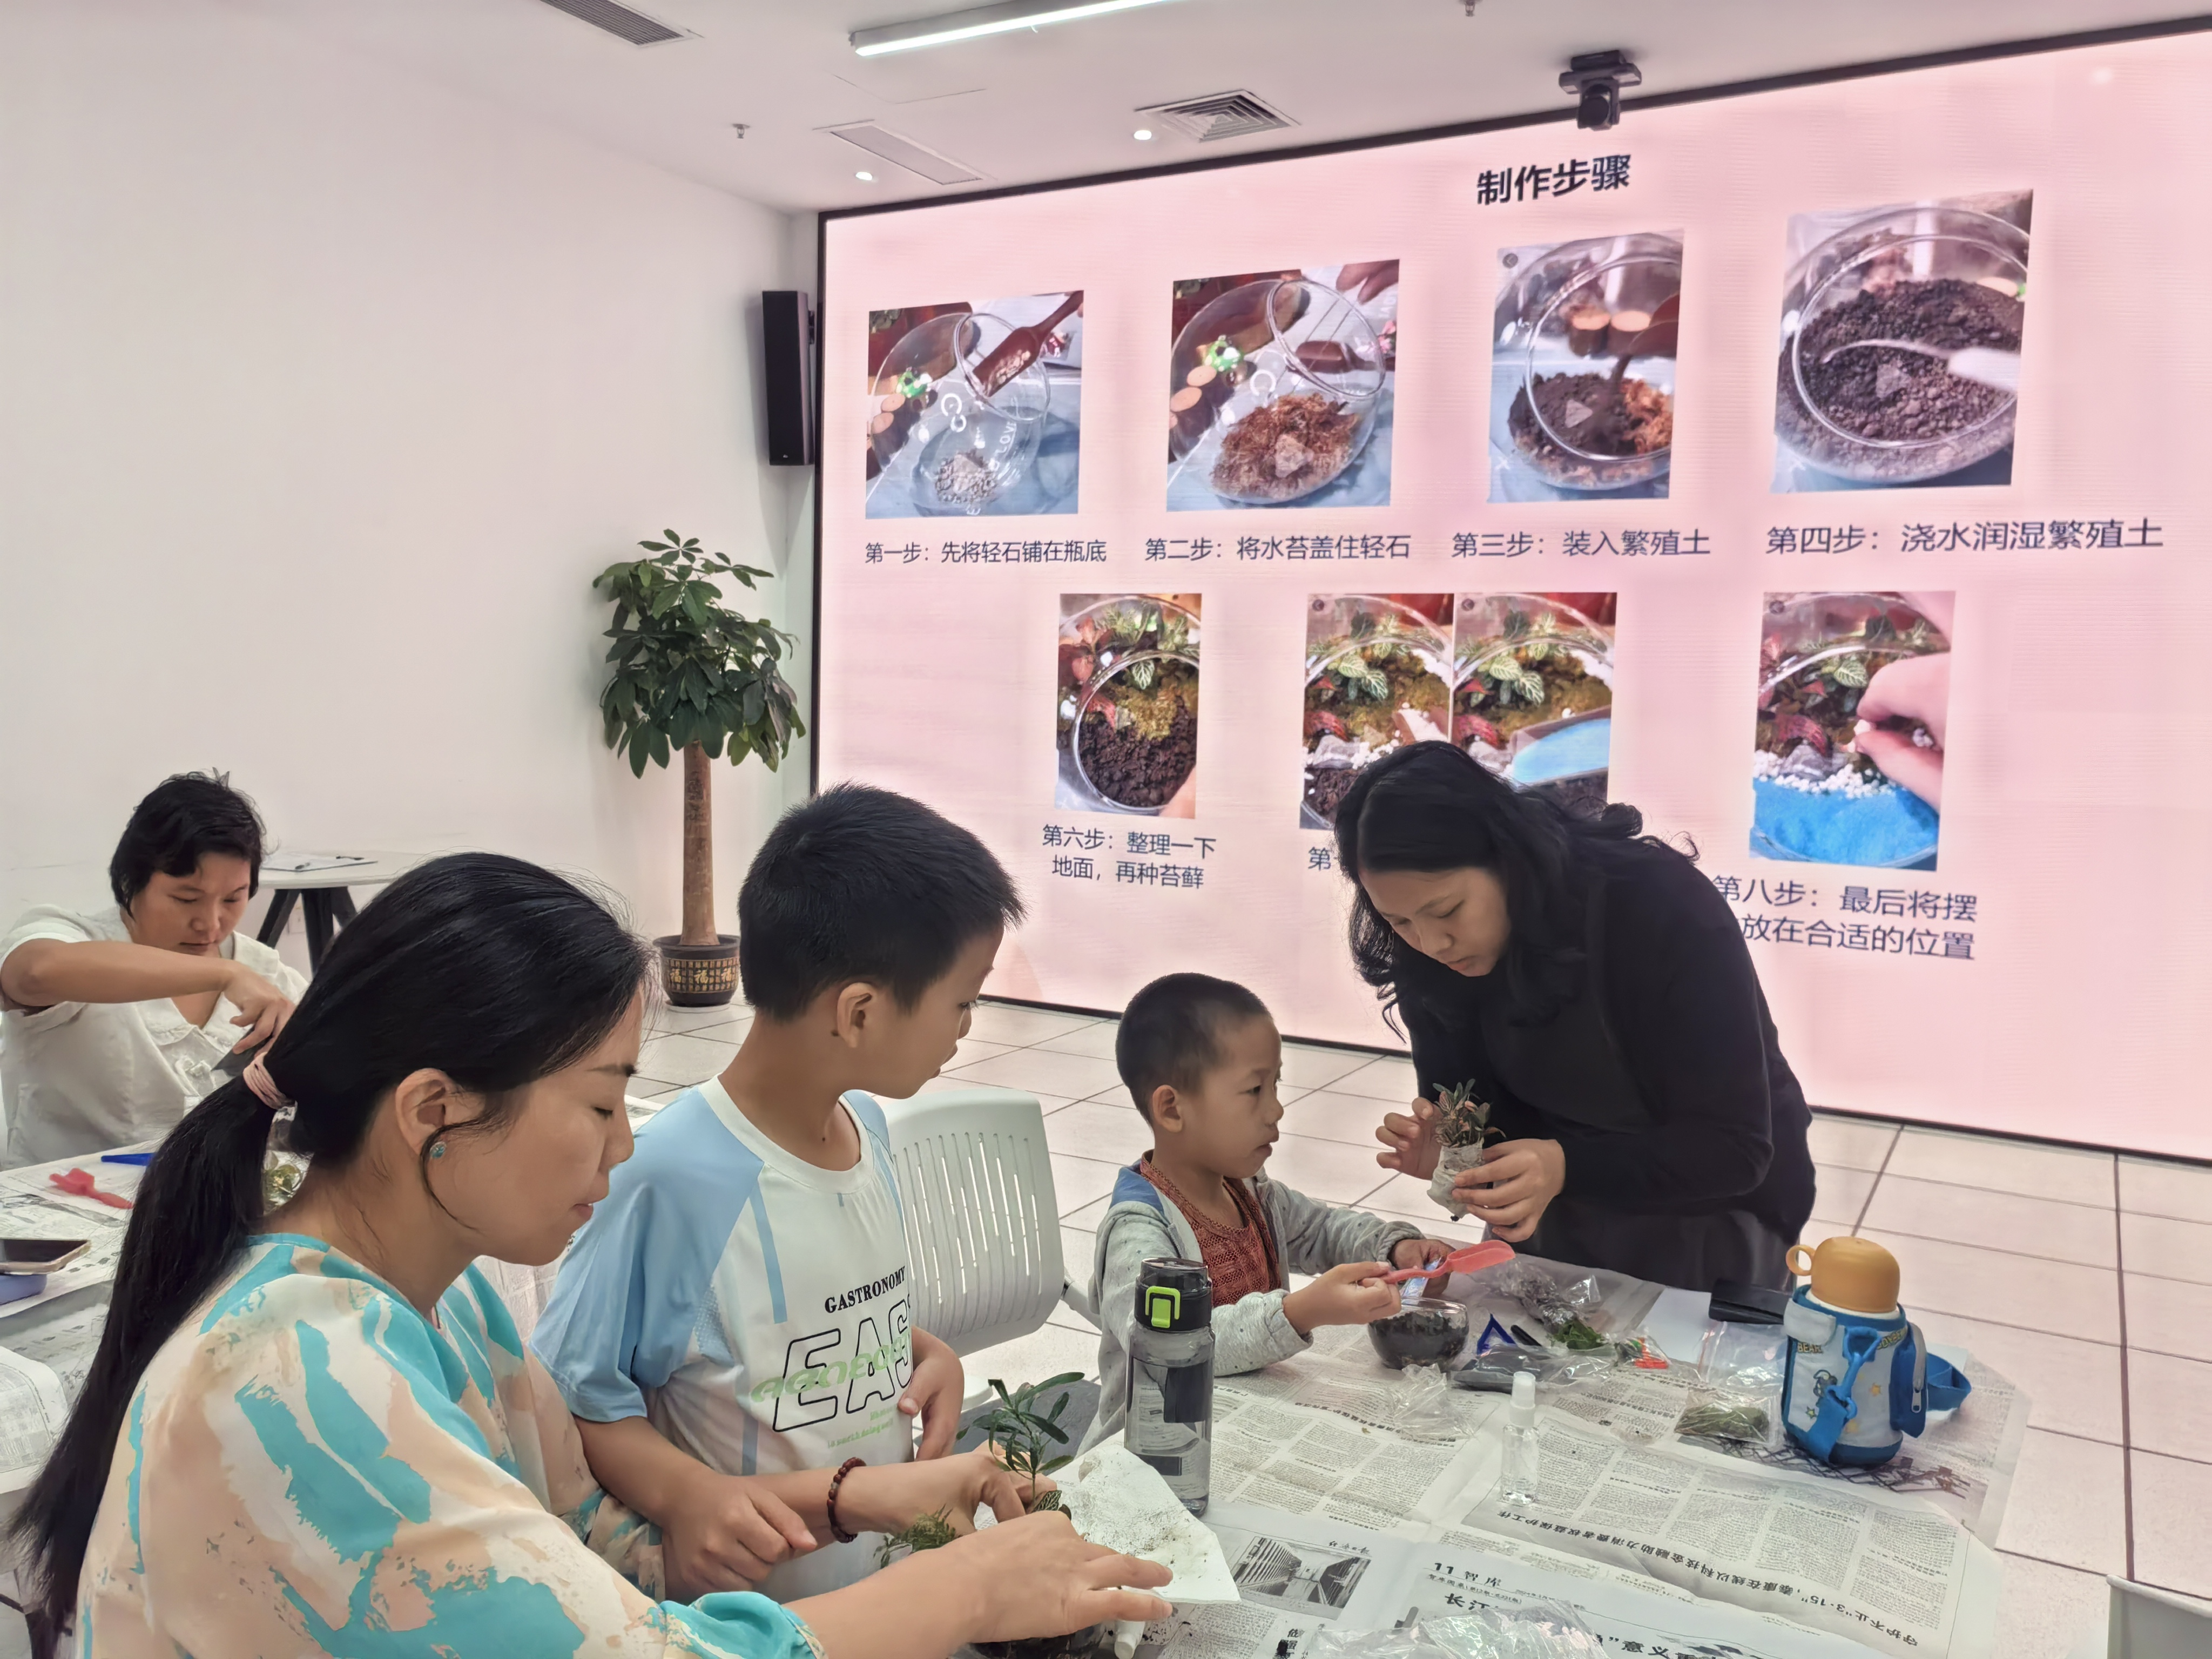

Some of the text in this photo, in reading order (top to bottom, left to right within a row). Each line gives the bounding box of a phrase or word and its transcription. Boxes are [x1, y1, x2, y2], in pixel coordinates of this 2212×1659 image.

[1477, 154, 1631, 205] 制作步骤
[865, 539, 1107, 564] 第一步：先将轻石铺在瓶底
[1145, 535, 1411, 561] 第二步：将水苔盖住轻石
[1452, 528, 1711, 558] 第三步：装入繁殖土
[1766, 518, 2163, 555] 第四步：浇水润湿繁殖土
[1042, 824, 1217, 861] 第六步：整理一下
[1051, 854, 1205, 889] 地面，再种苔藓
[1307, 846, 1339, 872] 第
[1712, 875, 1978, 922] 第八步：最后将摆
[1736, 913, 1975, 960] 放在合适的位置
[670, 968, 682, 983] 福
[694, 969, 709, 984] 福
[721, 967, 732, 983] 福
[824, 1265, 906, 1313] GASTRONOMY
